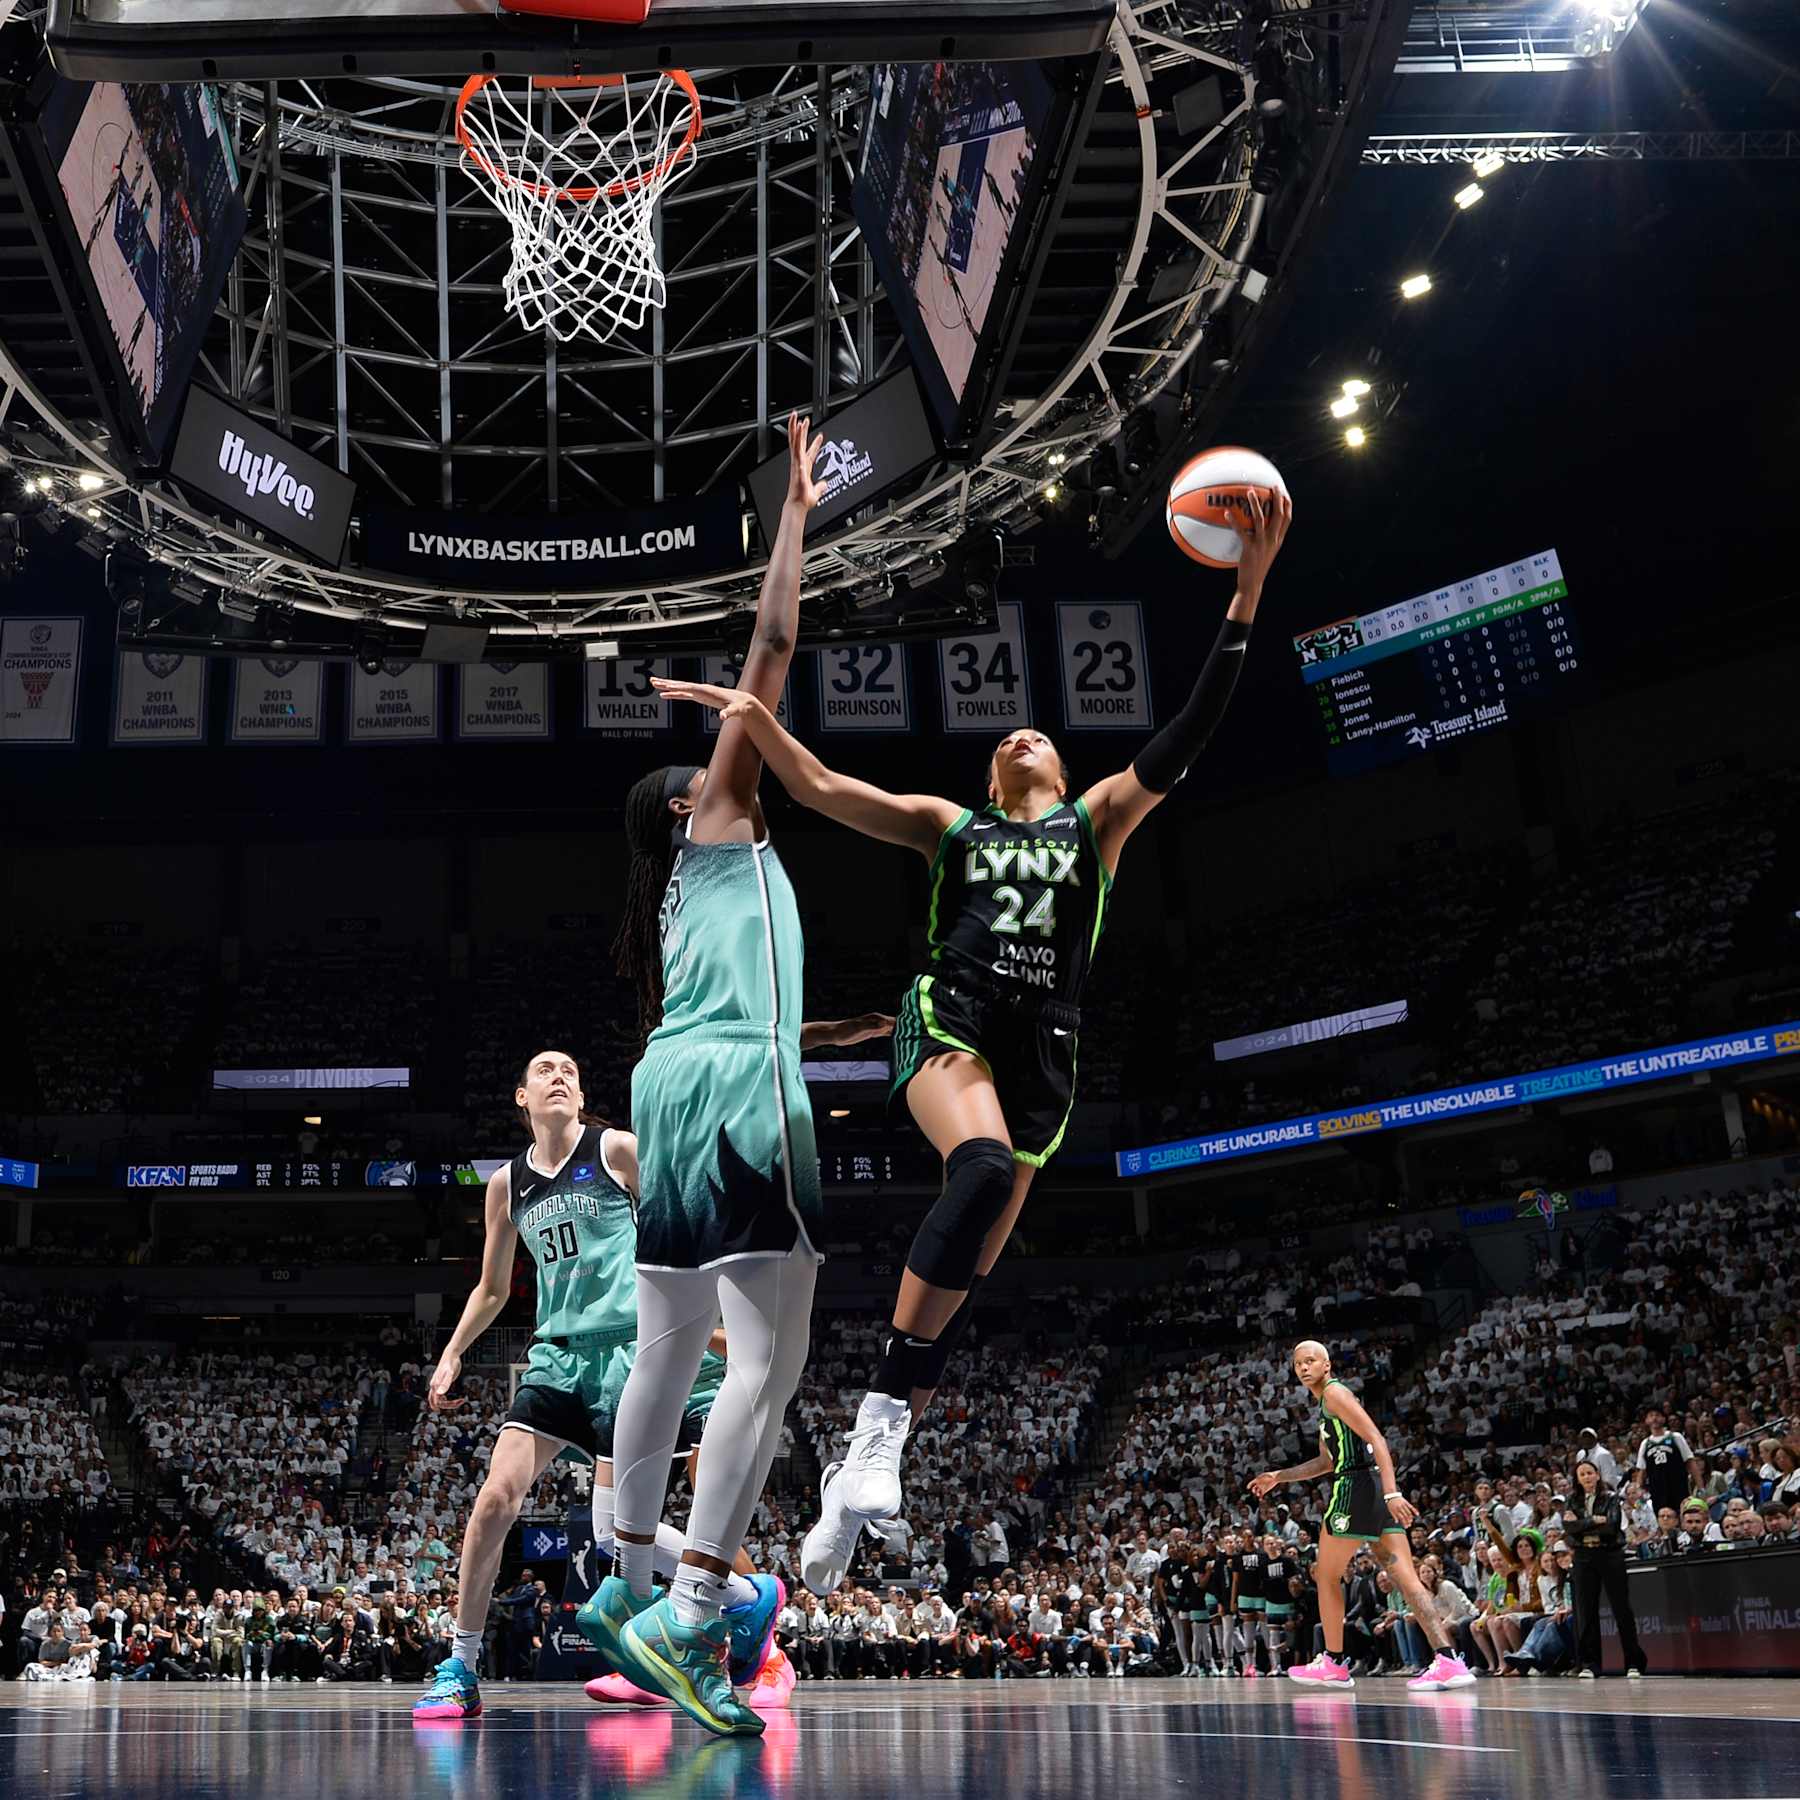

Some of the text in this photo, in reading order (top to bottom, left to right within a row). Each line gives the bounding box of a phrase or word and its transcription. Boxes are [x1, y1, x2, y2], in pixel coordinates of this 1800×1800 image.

[408, 524, 695, 561] LYNXBASKETBALL.COM
[1367, 628, 1381, 639] 0.0
[1390, 620, 1404, 631] 0.0
[1414, 612, 1428, 623] 0.0
[1467, 596, 1474, 604] 0
[1492, 587, 1499, 596] 0
[1518, 578, 1525, 586] 0
[1542, 570, 1548, 578] 0
[1444, 639, 1451, 648] 0
[1481, 627, 1488, 636] 0
[1542, 602, 1560, 615] 0/1
[1456, 617, 1471, 628] AST
[1334, 683, 1371, 700] Ionescu
[1448, 652, 1455, 662] 0
[1485, 640, 1492, 650] 0
[1546, 616, 1565, 629] 0/0
[1452, 666, 1459, 676] 0
[1489, 654, 1496, 664] 0
[1550, 630, 1568, 644] 0/1
[4, 659, 72, 669] CHAMPIONS
[831, 645, 895, 693] 32
[949, 642, 1019, 696] 34
[1072, 640, 1136, 693] 23
[1343, 712, 1370, 727] Jones
[1494, 668, 1501, 678] 0
[1554, 644, 1573, 658] 0/0
[1459, 694, 1467, 704] 0
[1497, 682, 1504, 692] 0
[1558, 658, 1577, 672] 0/0
[146, 691, 173, 701] 2011
[264, 690, 292, 700] 2013
[379, 689, 408, 700] 2015
[489, 686, 518, 697] 2017
[142, 704, 177, 715] WNBA
[259, 703, 296, 714] WNBA
[375, 703, 412, 714] WNBA
[485, 699, 523, 711] WNBA
[598, 703, 658, 719] WHALEN
[827, 700, 901, 716] BRUNSON
[957, 700, 1017, 717] FOWLES
[1080, 698, 1135, 714] MOORE
[122, 718, 195, 729] CHAMPIONS
[239, 717, 313, 728] CHAMPIONS
[357, 716, 430, 728] CHAMPIONS
[467, 713, 541, 725] CHAMPIONS
[1430, 699, 1506, 735] Treasure Island
[965, 848, 1081, 887] LYNX
[990, 885, 1056, 937] 24
[1000, 943, 1056, 966] MAYO
[992, 960, 1056, 989] CLINIC
[1148, 1144, 1200, 1165] CURING
[1200, 1134, 1229, 1156] THE
[1228, 1122, 1314, 1151] UNCURABLE
[1318, 1111, 1382, 1134] SOLVING
[1382, 1103, 1414, 1123] THE
[1413, 1083, 1516, 1116] UNSOLVABLE
[1519, 1068, 1602, 1095] TREATING
[1602, 1060, 1639, 1081] THE
[1639, 1036, 1768, 1073] UNTREATABLE
[127, 1166, 186, 1187] KFAN
[190, 1164, 238, 1175] SPORTS RADIO
[189, 1176, 200, 1186] FM
[441, 1175, 471, 1184] 5 0
[538, 1219, 580, 1267] 30
[272, 1270, 290, 1281] 120
[1744, 1608, 1800, 1631] FINALS
[562, 1638, 594, 1646] FINAL
